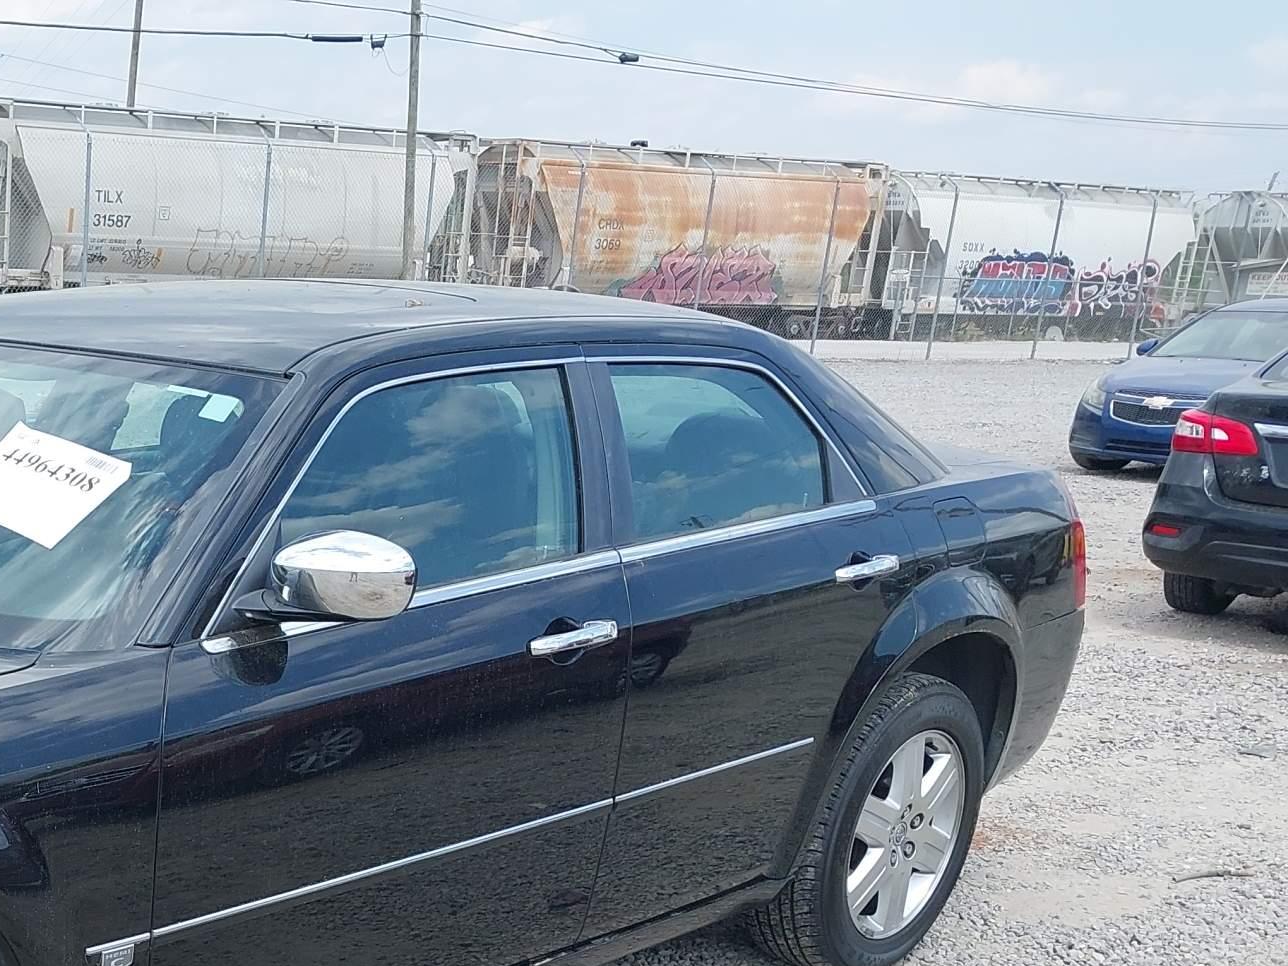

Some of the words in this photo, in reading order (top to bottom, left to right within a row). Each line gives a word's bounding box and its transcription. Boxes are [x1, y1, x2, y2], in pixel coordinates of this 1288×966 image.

[95, 189, 123, 204] TILX
[92, 213, 132, 228] 31587
[594, 238, 621, 250] 3069
[1, 448, 101, 493] 44964308
[105, 949, 131, 960] HEMI
